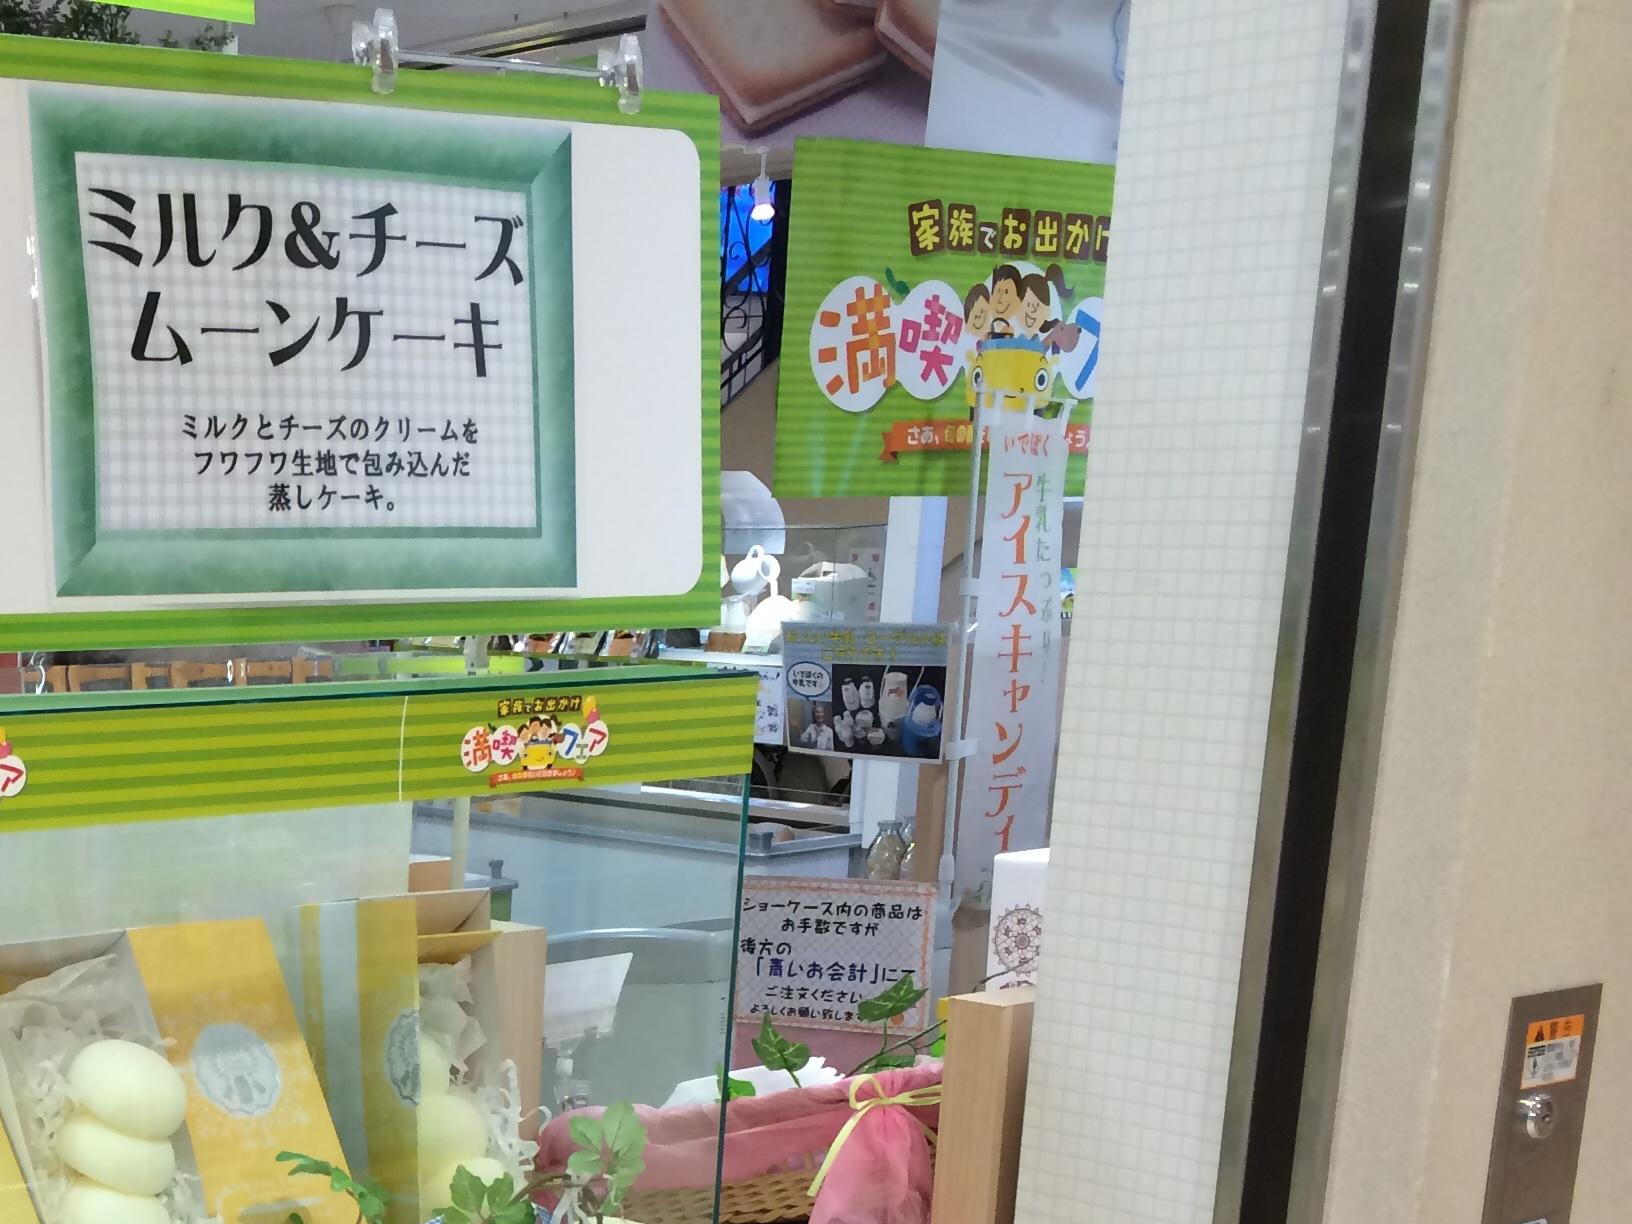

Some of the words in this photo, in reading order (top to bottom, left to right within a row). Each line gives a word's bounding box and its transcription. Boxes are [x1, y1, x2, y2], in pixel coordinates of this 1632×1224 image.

[88, 186, 526, 287] ミルク&チーズ
[129, 290, 505, 379] ムーンケーキ
[181, 414, 479, 447] ミルクとチーズのクリームを
[193, 450, 472, 481] フワフワ生地で包み込んだ
[267, 481, 398, 512] 蒸しケーキ。
[742, 898, 923, 920] ショーケース内の商品は
[781, 918, 879, 936] お手数ですが
[740, 937, 792, 955] 後方の
